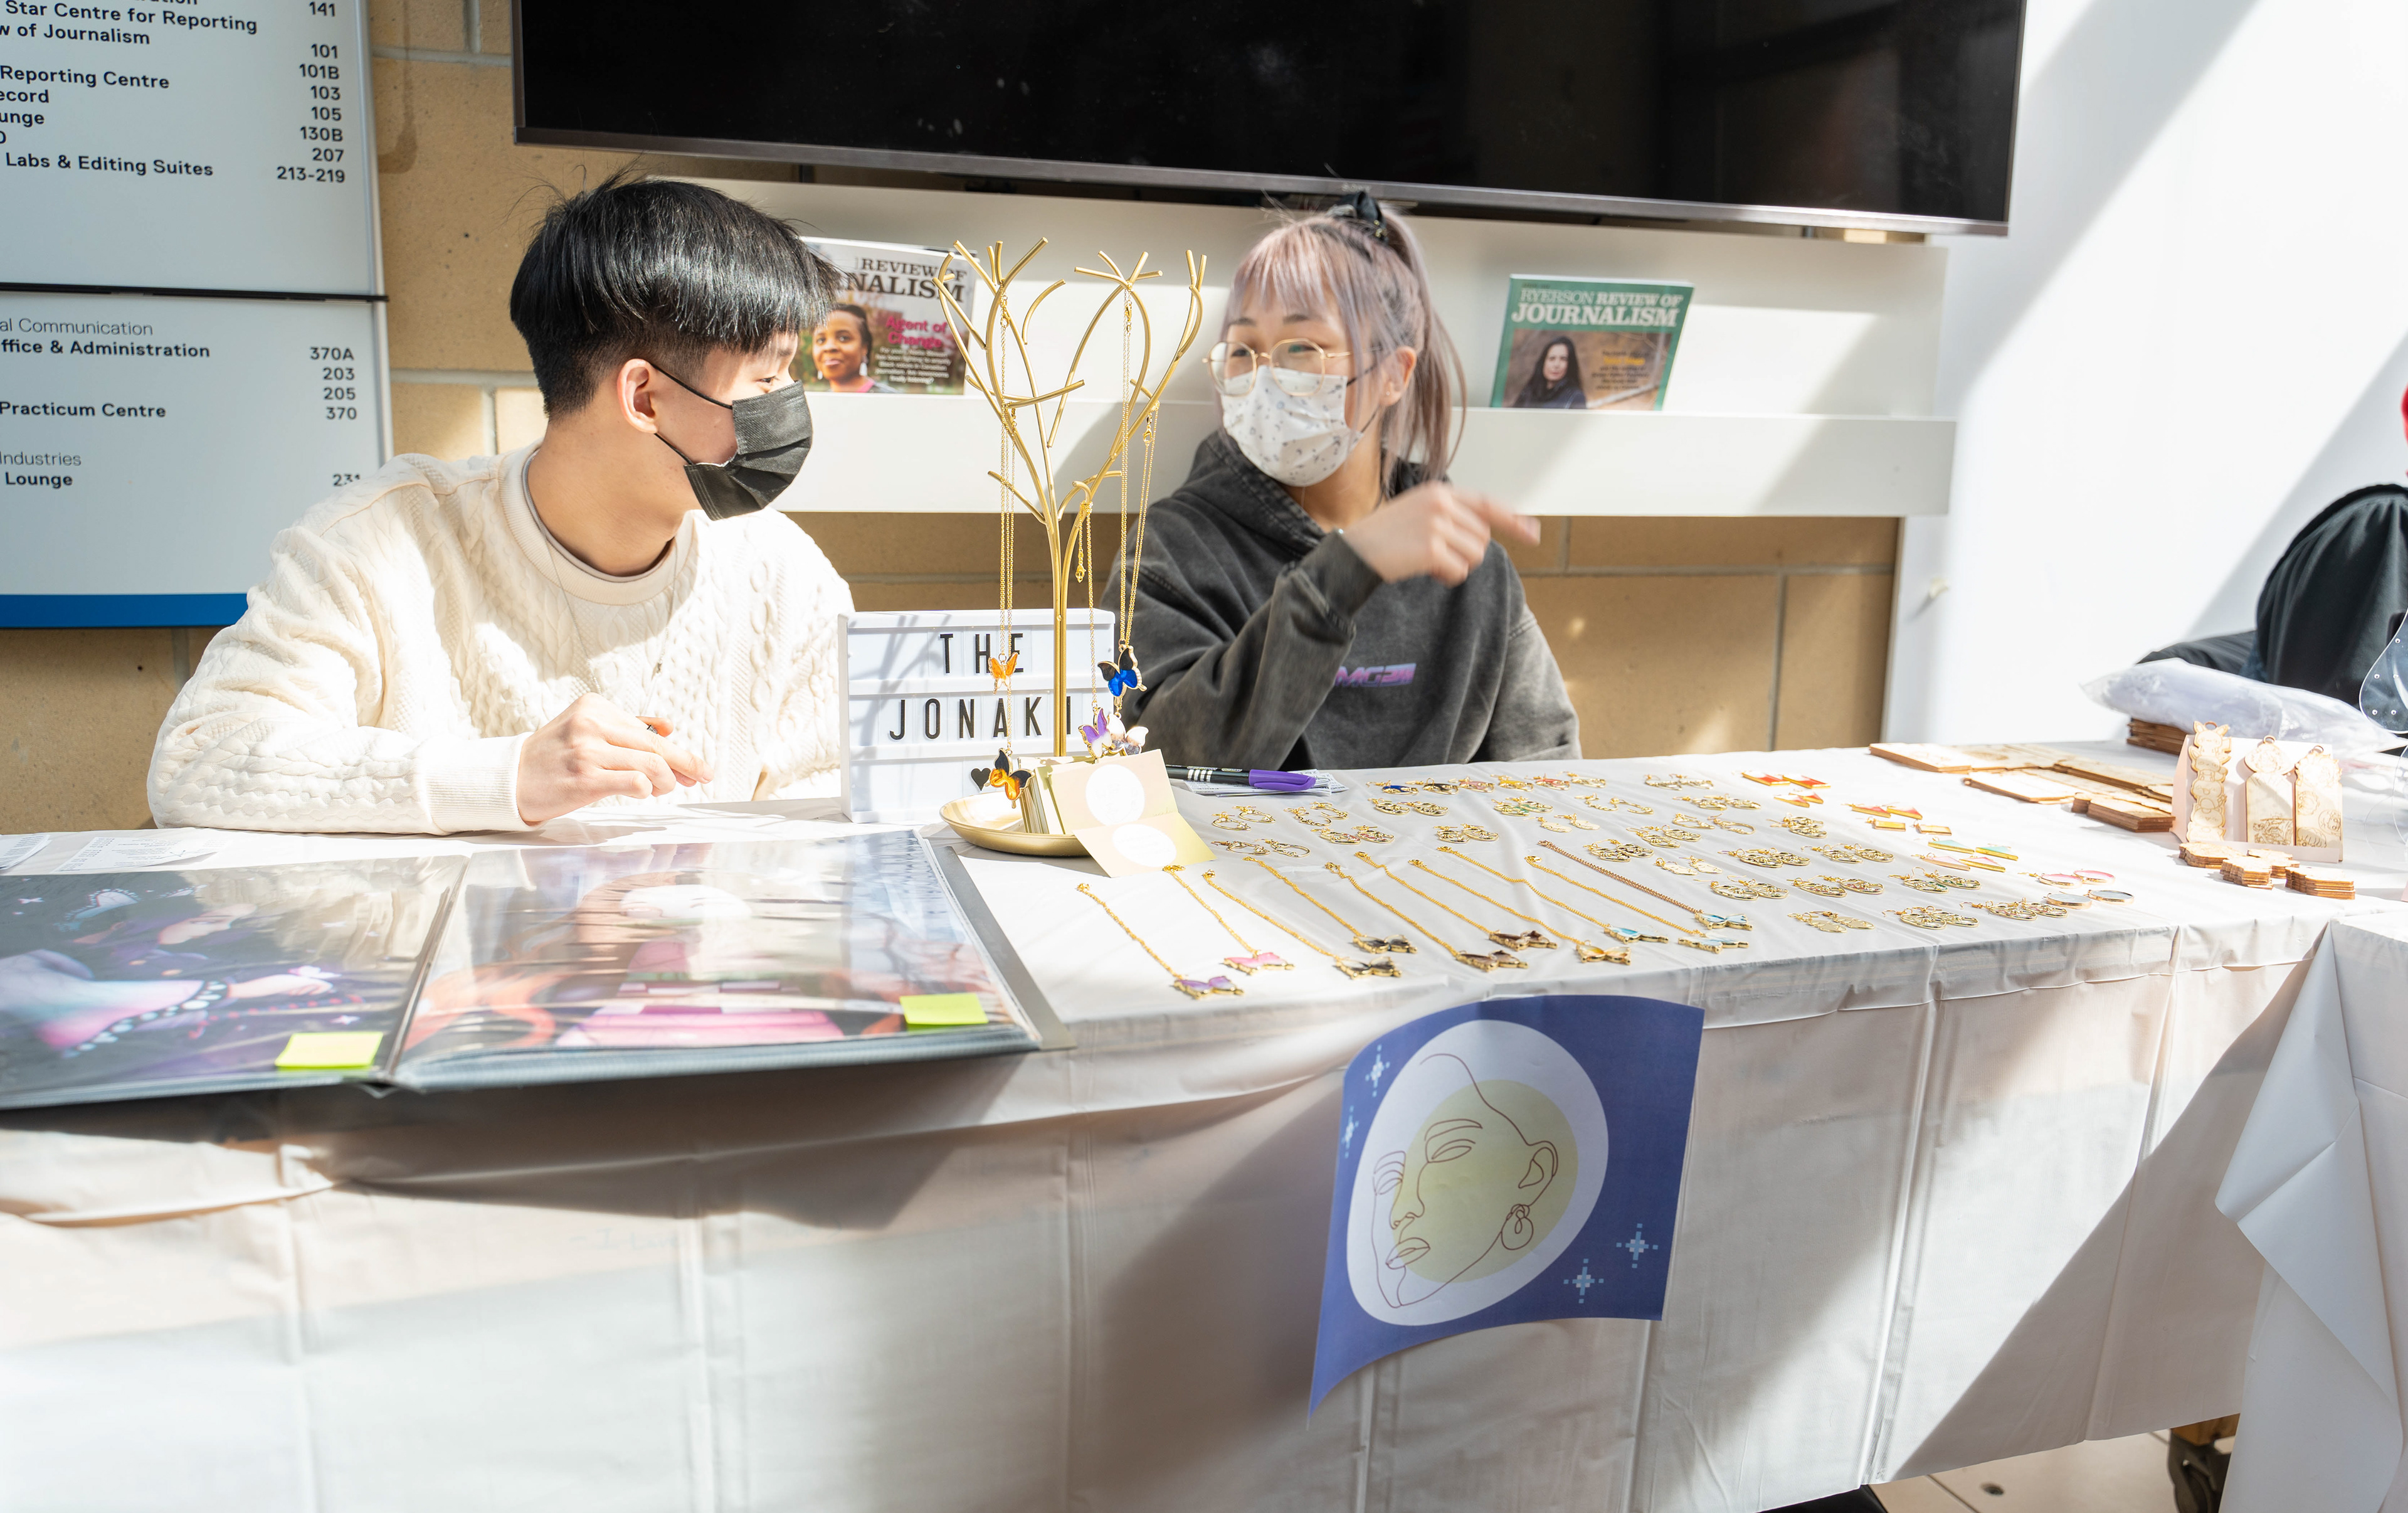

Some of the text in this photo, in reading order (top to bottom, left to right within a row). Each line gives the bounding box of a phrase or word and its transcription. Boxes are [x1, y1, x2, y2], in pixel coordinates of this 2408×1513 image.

[6, 0, 257, 35] Star Centre for Reporting
[309, 2, 336, 18] 141
[18, 23, 36, 37] of
[44, 24, 150, 45] Journalism
[311, 44, 338, 59] 101
[0, 65, 169, 88] Reporting Centre
[299, 64, 340, 80] 101B
[311, 85, 341, 101] 103
[312, 106, 342, 121] 105
[300, 126, 344, 142] 130B
[312, 148, 344, 162] 207
[6, 152, 213, 176] Labs & Editing Suites
[277, 166, 346, 183] 213-219
[861, 258, 938, 277] REVIEW
[1520, 288, 1684, 307] RYERSON REVIEW OF
[1511, 302, 1681, 328] JOURNALISM
[19, 317, 153, 336] Communication
[886, 316, 948, 333] Agent of
[50, 340, 63, 353] &
[70, 341, 210, 358] Administration
[888, 331, 942, 350] Change
[310, 346, 354, 361] 370A
[323, 367, 355, 381] 203
[323, 387, 356, 400] 205
[0, 401, 166, 417] Practicum Centre
[326, 406, 357, 420] 370
[0, 450, 82, 466] Industries
[6, 471, 73, 489] Lounge
[940, 632, 1024, 674] THE
[889, 696, 1072, 740] JONAKI
